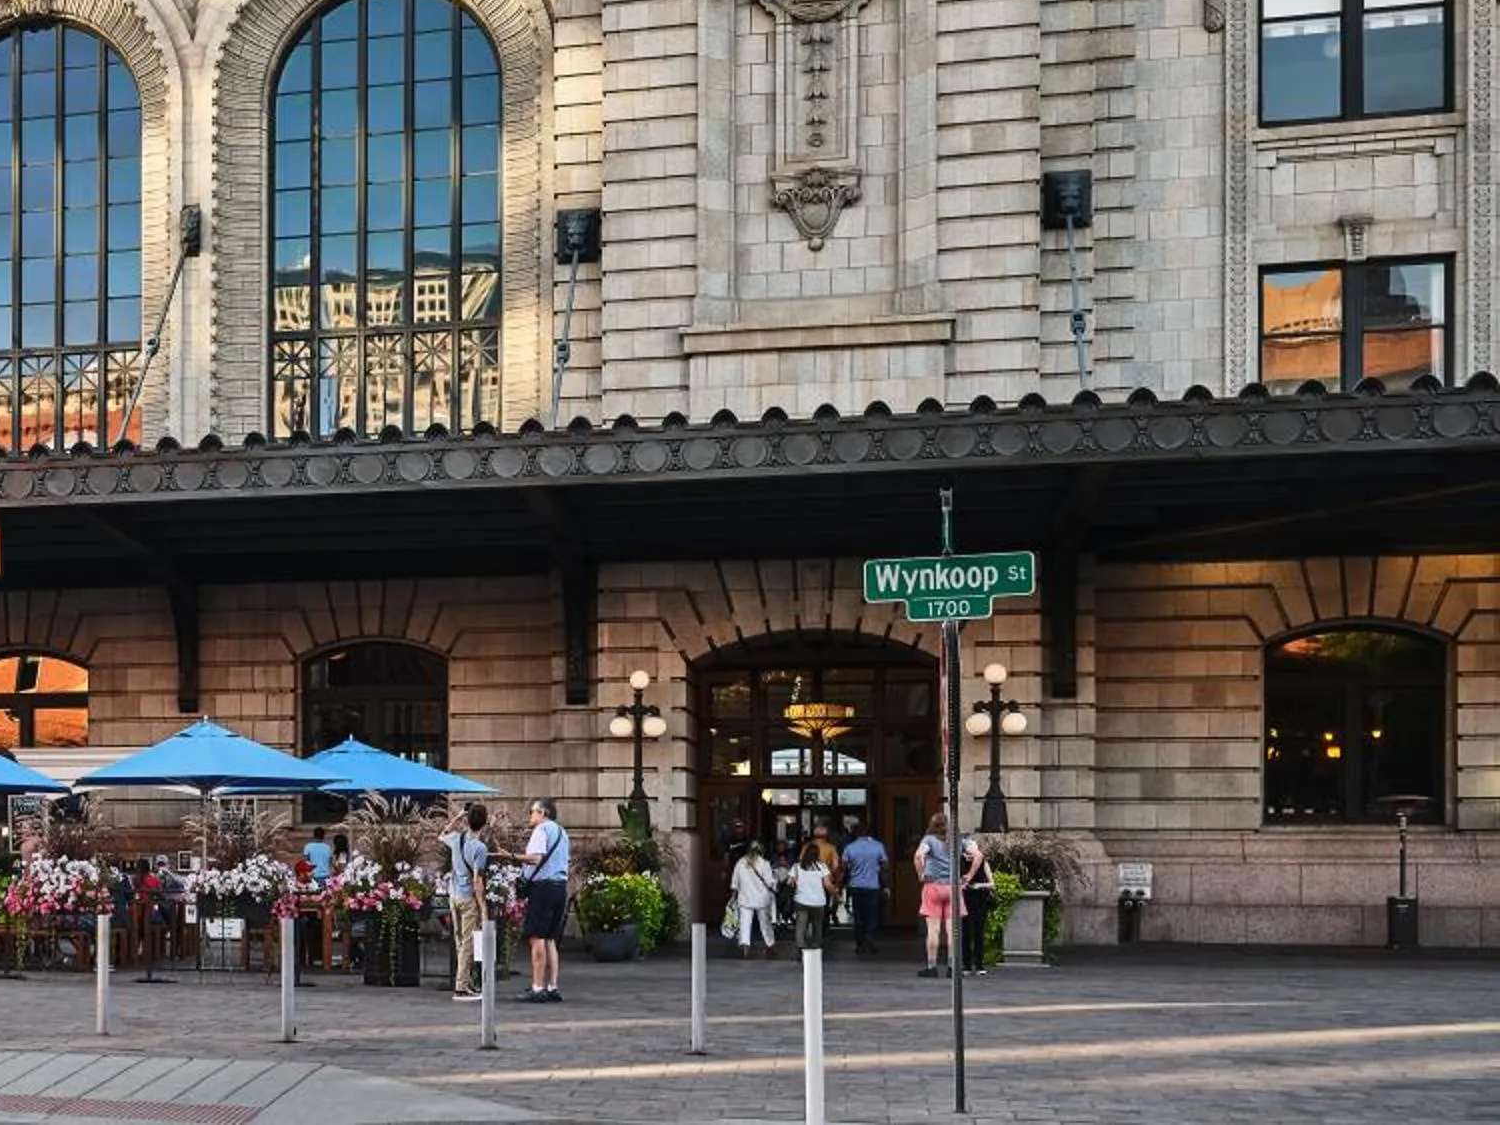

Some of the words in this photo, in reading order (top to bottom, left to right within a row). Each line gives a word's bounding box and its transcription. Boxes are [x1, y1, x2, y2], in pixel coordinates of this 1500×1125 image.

[875, 562, 999, 595] Wynkoop
[1008, 564, 1027, 581] St
[927, 599, 971, 617] 1700
